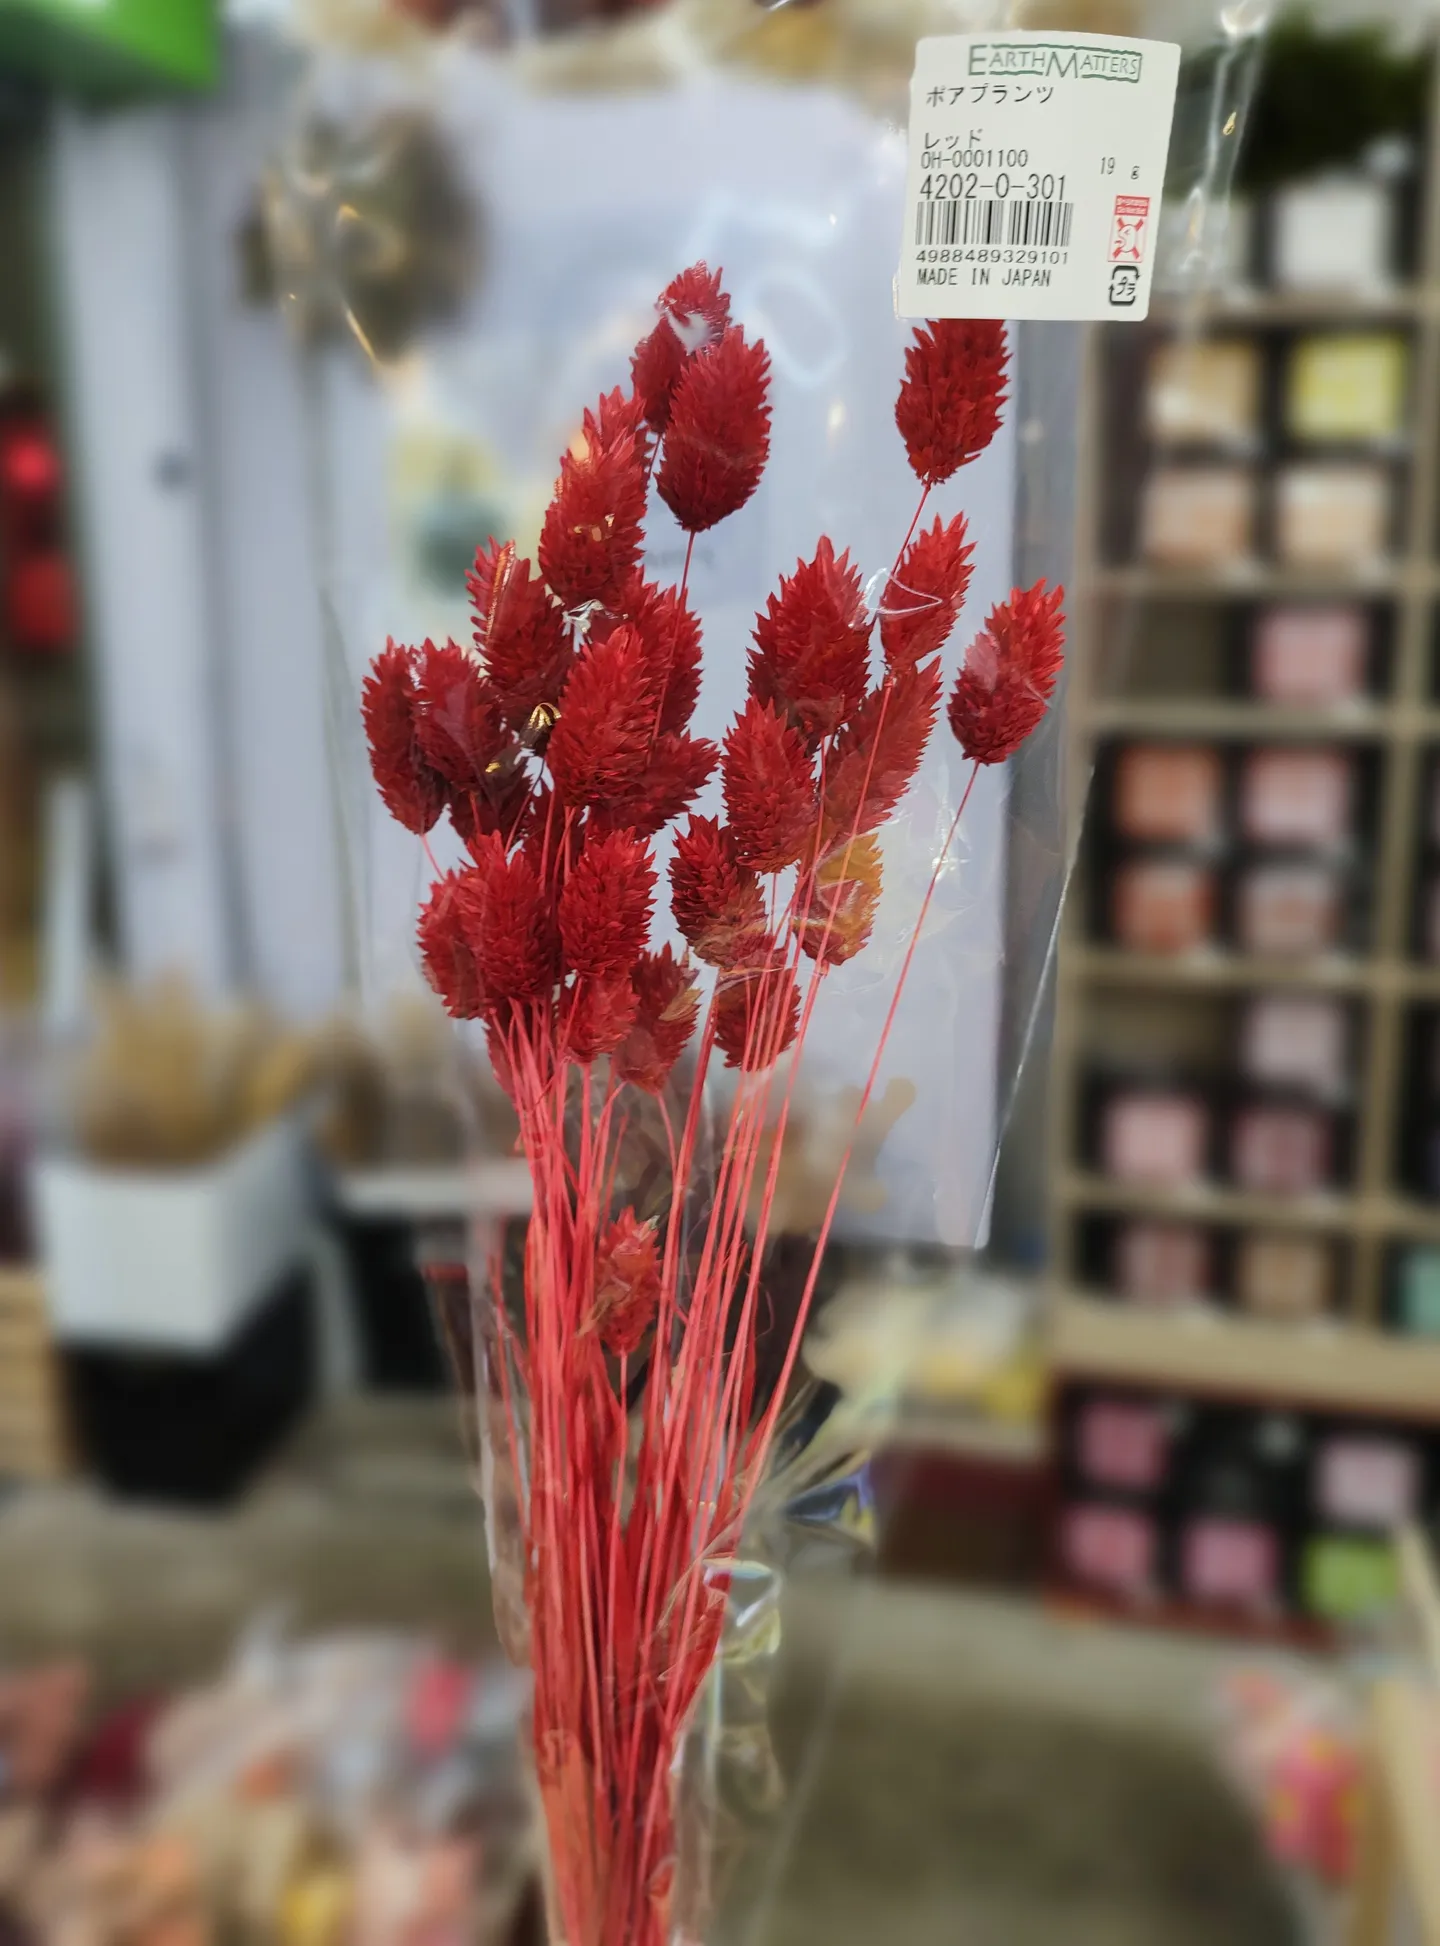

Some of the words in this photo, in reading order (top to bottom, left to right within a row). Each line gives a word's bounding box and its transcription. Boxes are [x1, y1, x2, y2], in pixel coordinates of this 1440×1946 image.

[925, 129, 983, 150] レッド
[1100, 156, 1115, 175] 19
[920, 173, 1066, 201] 4202-0-301
[916, 249, 1069, 265] 4988489329101
[917, 268, 958, 286] MADE
[972, 268, 990, 286] IN
[1002, 268, 1051, 287] JAPAN
[1116, 276, 1136, 296] プラ
